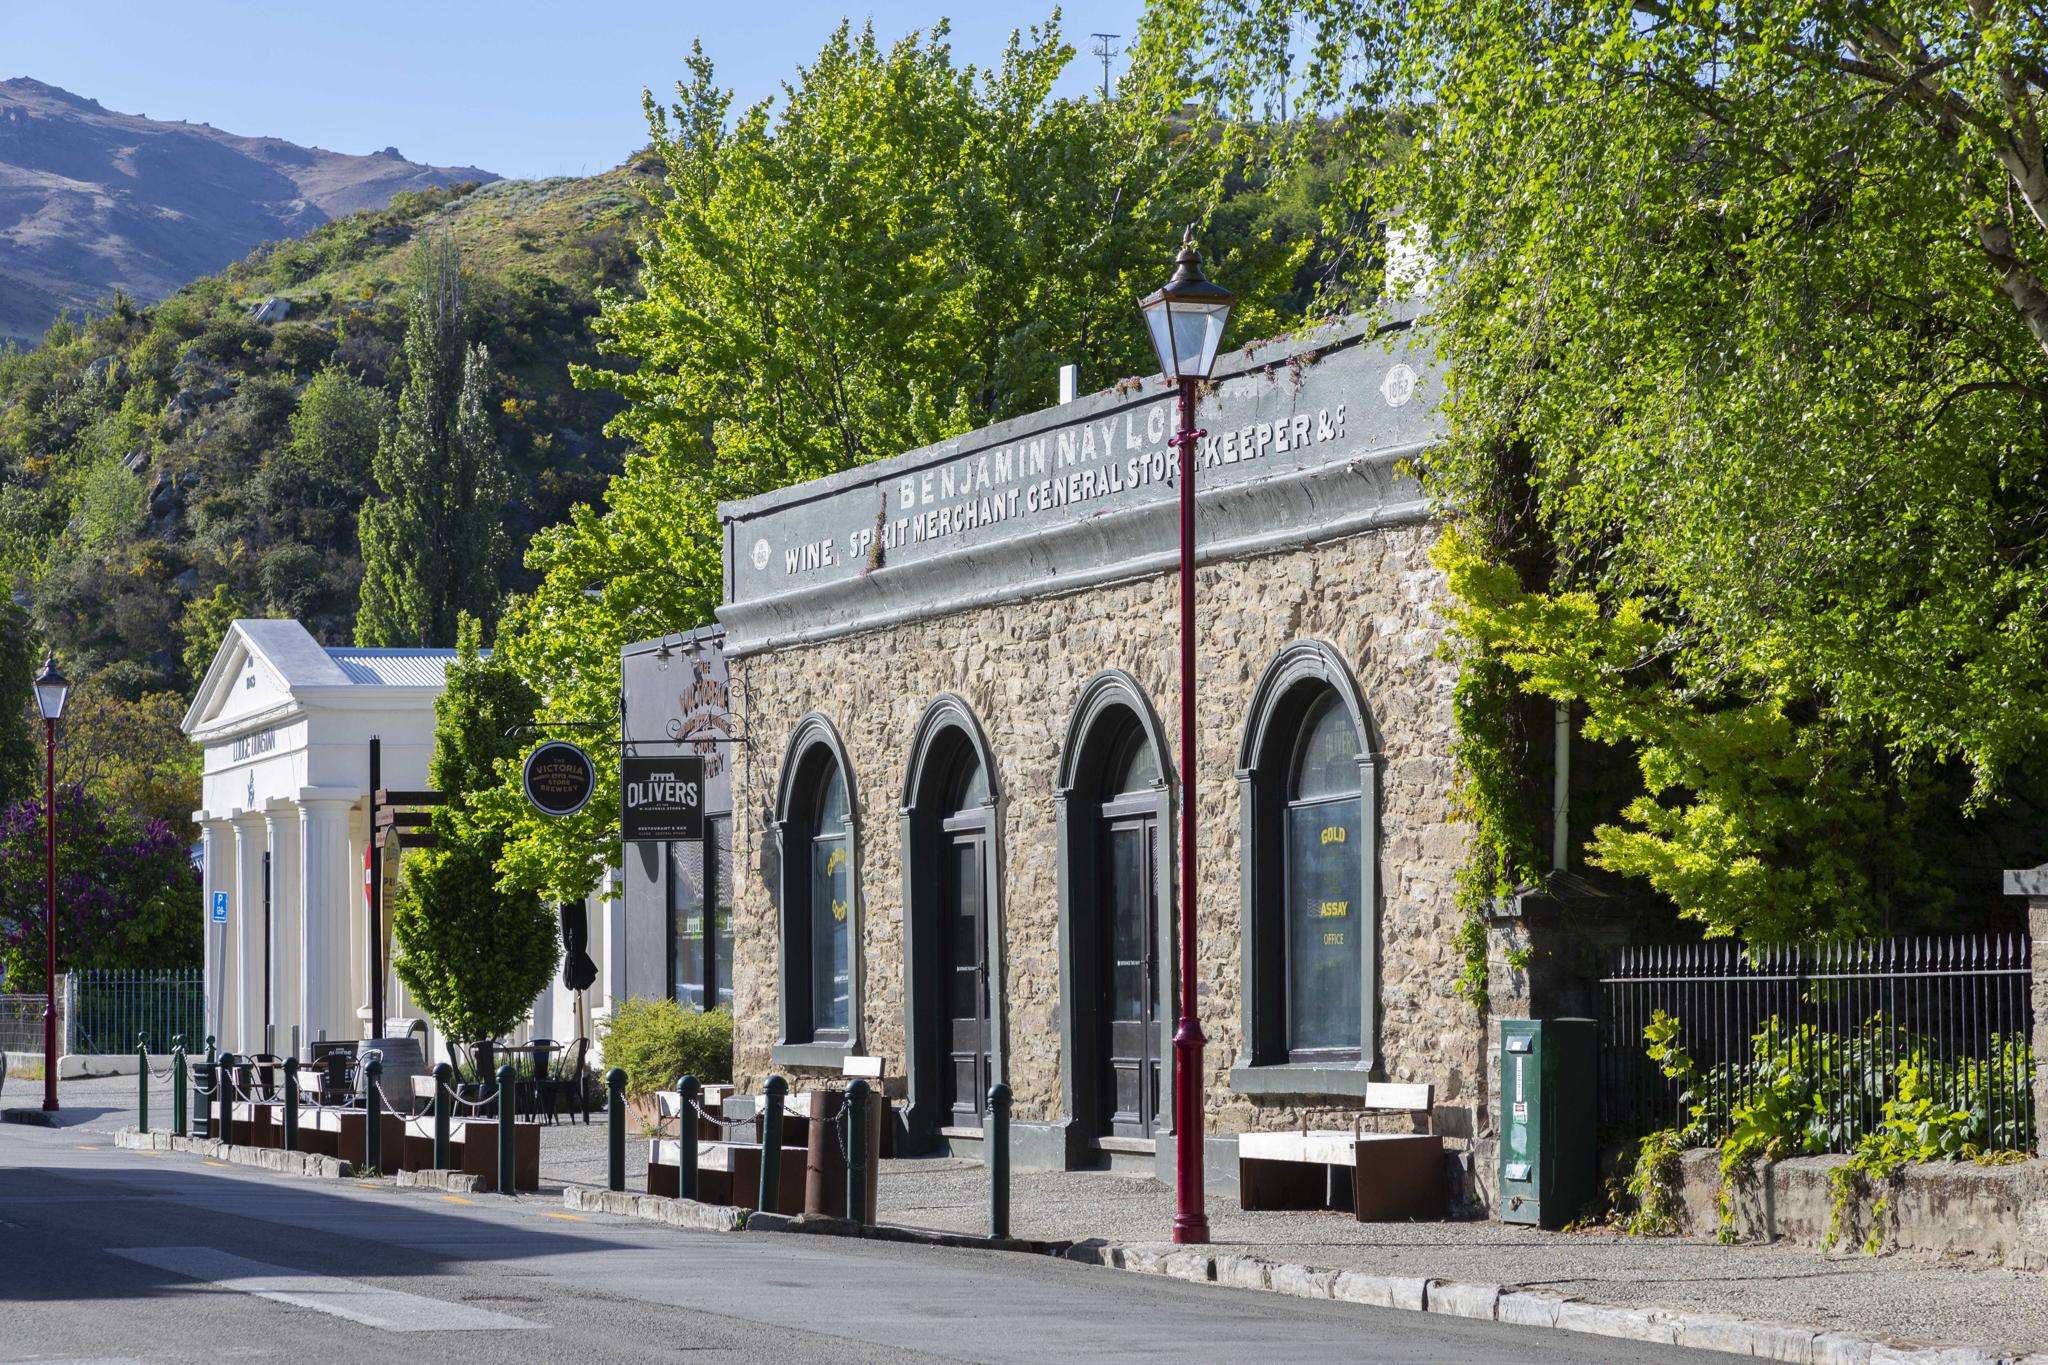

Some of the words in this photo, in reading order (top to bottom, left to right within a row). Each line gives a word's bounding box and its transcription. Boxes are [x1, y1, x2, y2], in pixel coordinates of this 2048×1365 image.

[900, 438, 1045, 510] BENJAMIN
[913, 488, 1024, 543] MERCHANT,
[1027, 462, 1123, 512] GENERAL
[536, 763, 583, 776] VICTORIA
[540, 784, 578, 793] BREWERY
[627, 782, 698, 808] OLIVERS
[1321, 827, 1346, 844] GOLD
[218, 894, 223, 905] P
[1320, 901, 1348, 916] ASSAY
[1323, 934, 1345, 945] OFFICE
